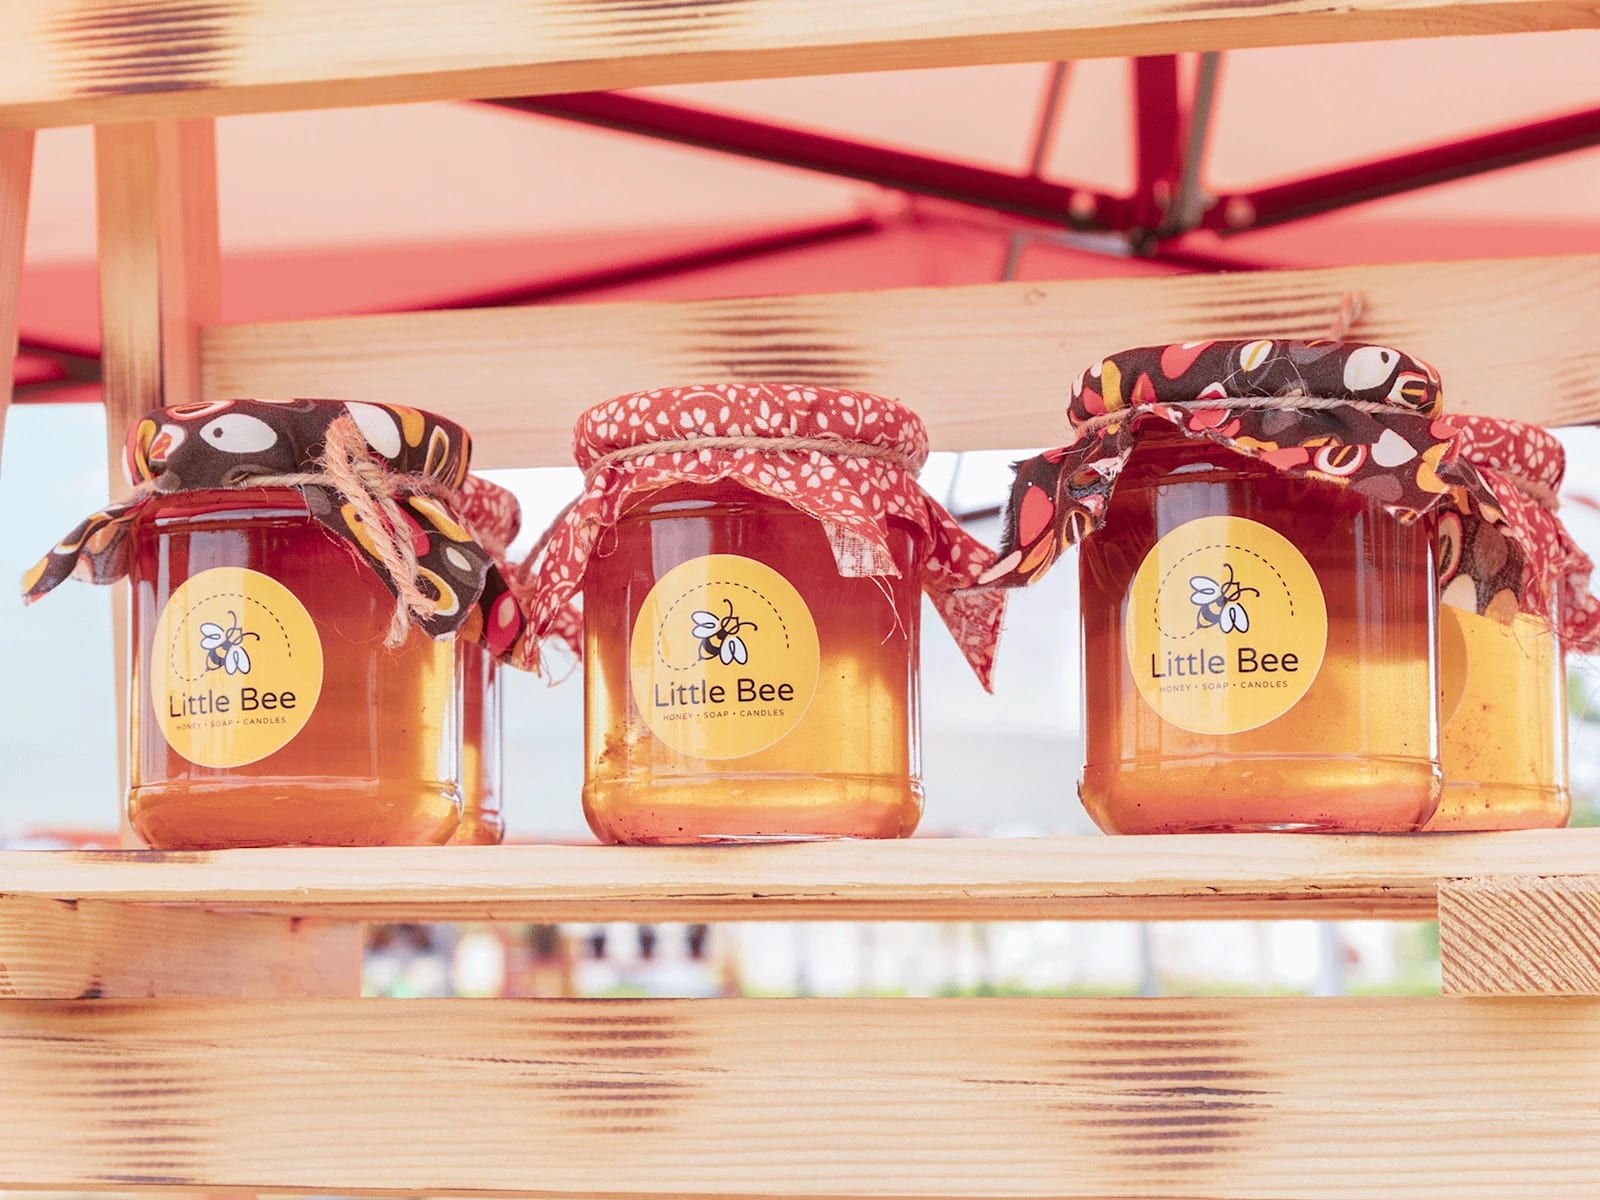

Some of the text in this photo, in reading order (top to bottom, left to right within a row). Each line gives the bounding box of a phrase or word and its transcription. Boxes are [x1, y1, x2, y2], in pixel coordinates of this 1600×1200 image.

[1151, 647, 1299, 678] Little Bee
[655, 678, 794, 707] Little Bee
[1159, 680, 1289, 693] HONEY SOAP CANDLES
[169, 687, 296, 717] Little Bee
[176, 716, 287, 731] HONEY SOAP CANDLES
[663, 708, 785, 721] HONEY SOAP CANDLES
